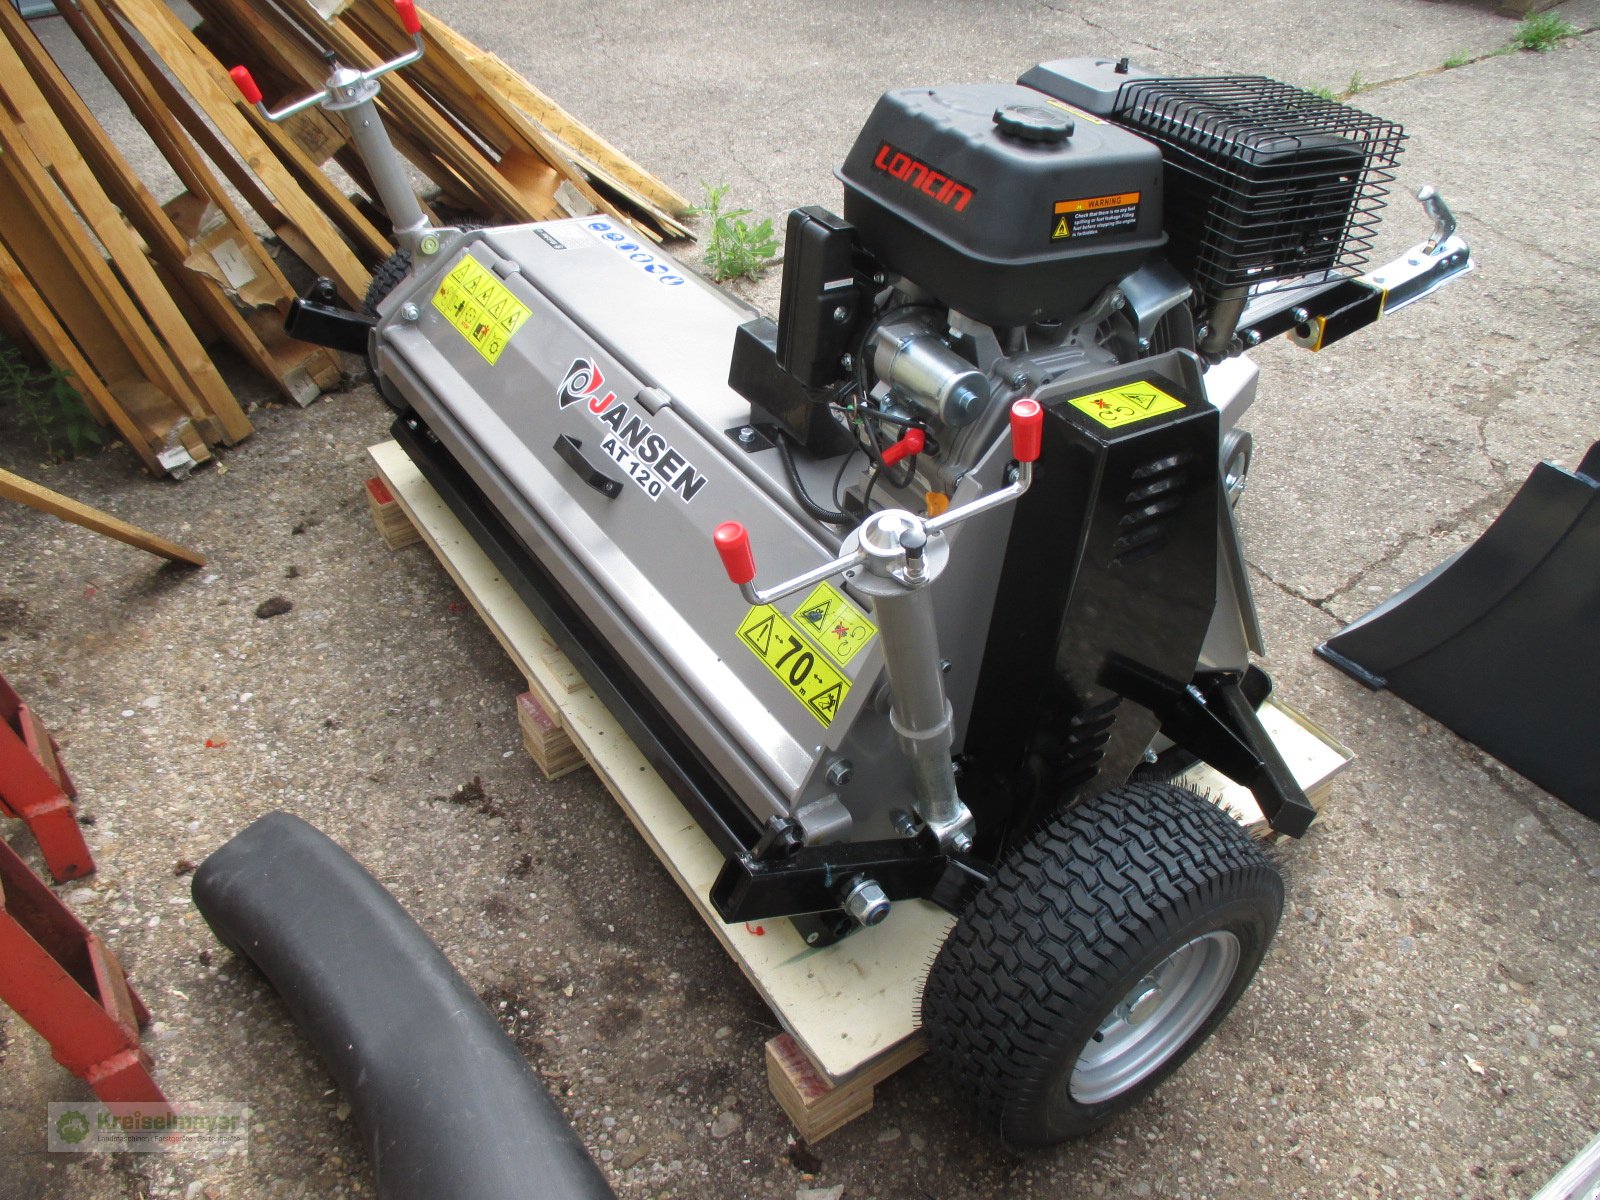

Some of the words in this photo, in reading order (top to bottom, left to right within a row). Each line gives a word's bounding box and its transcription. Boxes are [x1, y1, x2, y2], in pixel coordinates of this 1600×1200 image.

[1088, 197, 1121, 208] WARNING
[588, 391, 707, 503] JANSEN
[602, 438, 629, 462] AT
[630, 461, 662, 497] 120
[775, 635, 815, 686] 70
[799, 687, 806, 696] m
